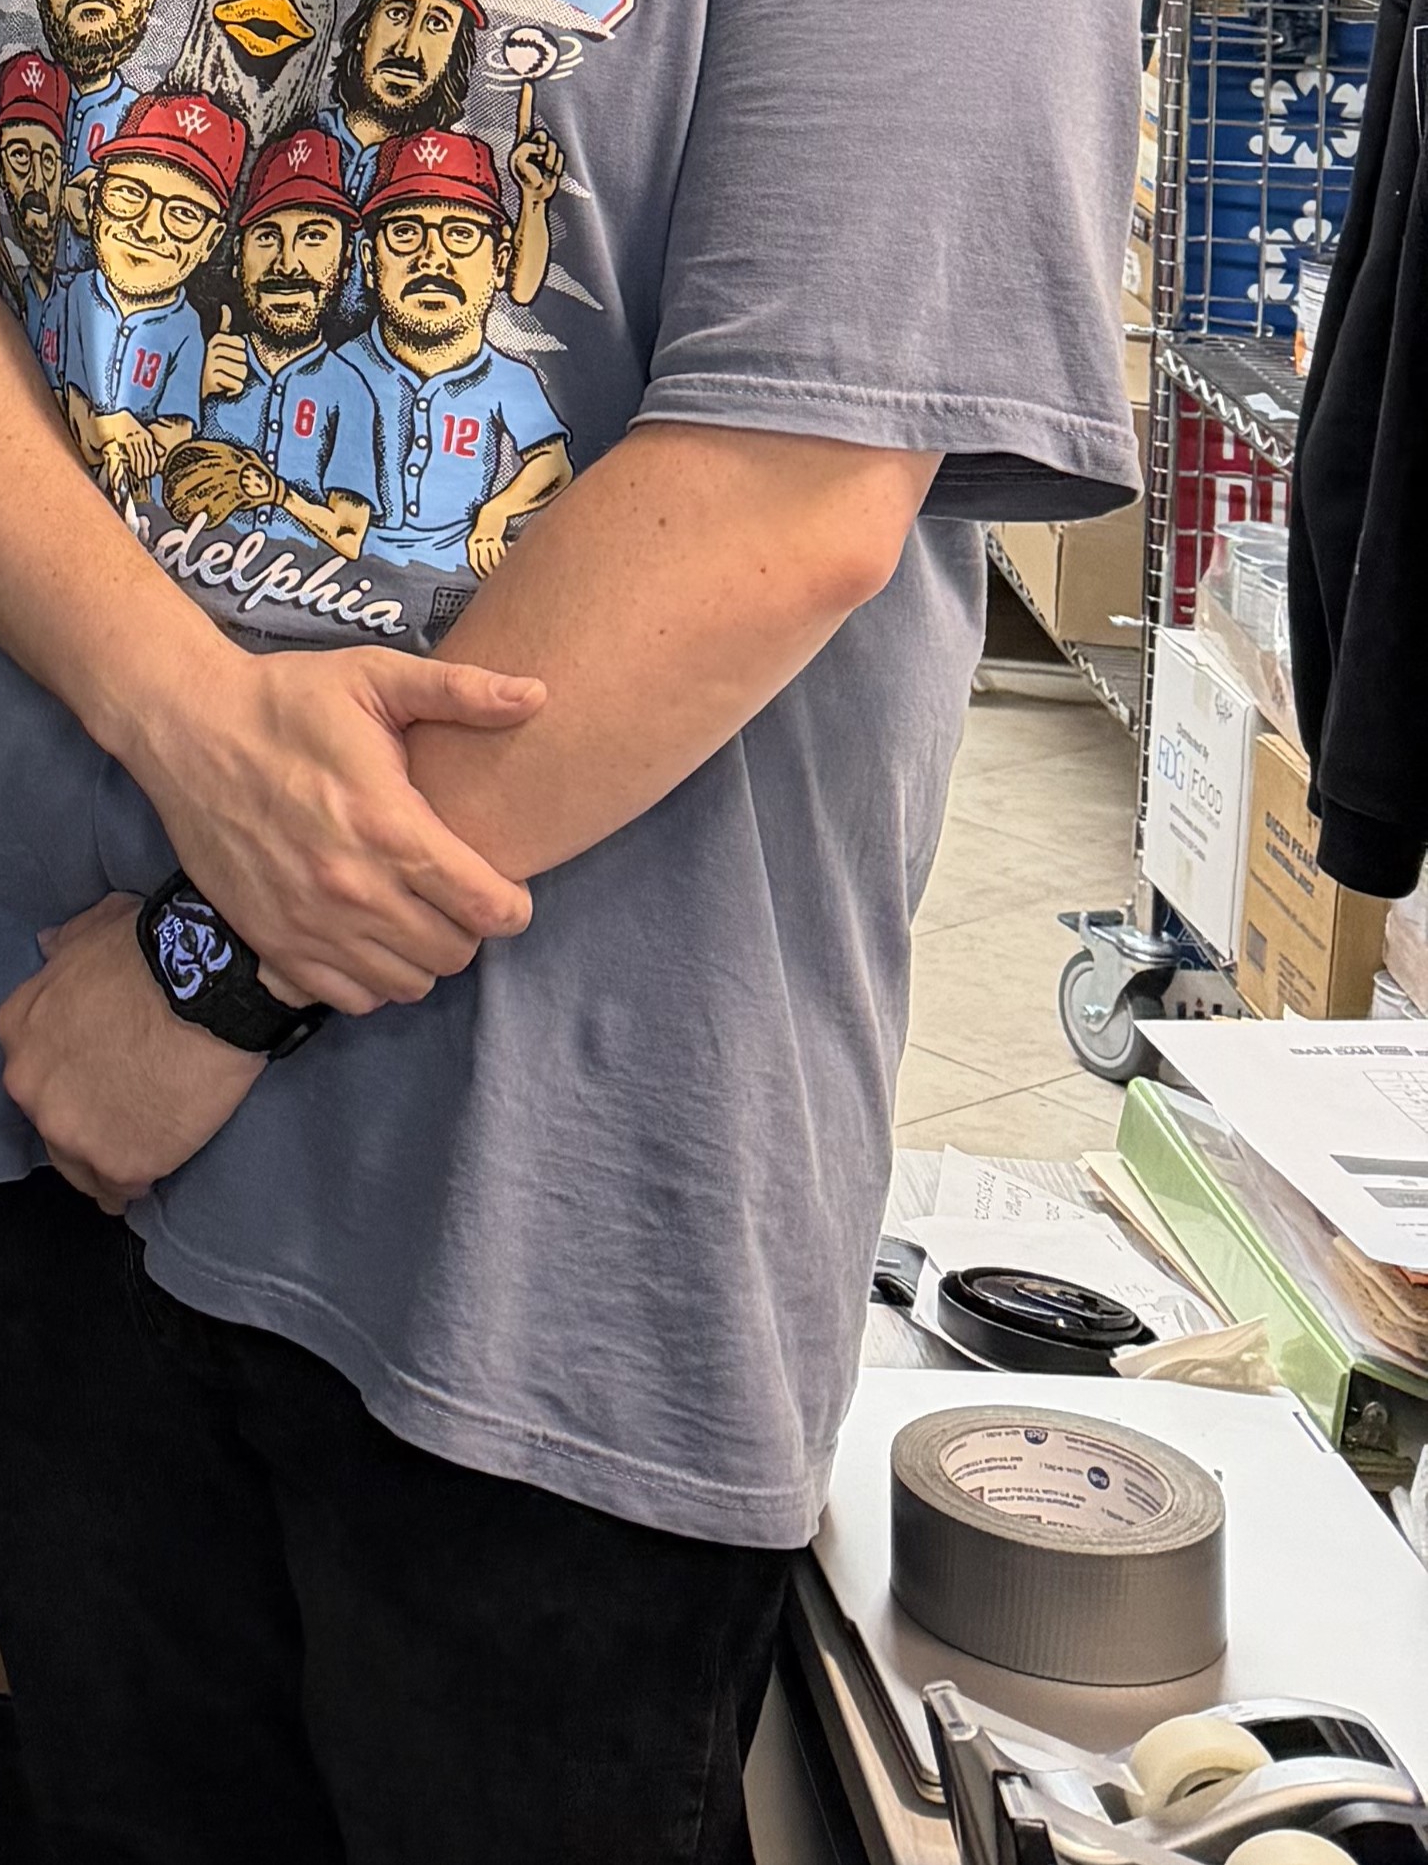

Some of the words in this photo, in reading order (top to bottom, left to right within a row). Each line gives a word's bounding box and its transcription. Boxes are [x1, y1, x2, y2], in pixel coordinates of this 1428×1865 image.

[131, 348, 162, 390] 13
[293, 397, 316, 437] 6
[442, 413, 480, 457] 12
[1192, 768, 1223, 815] FOOD
